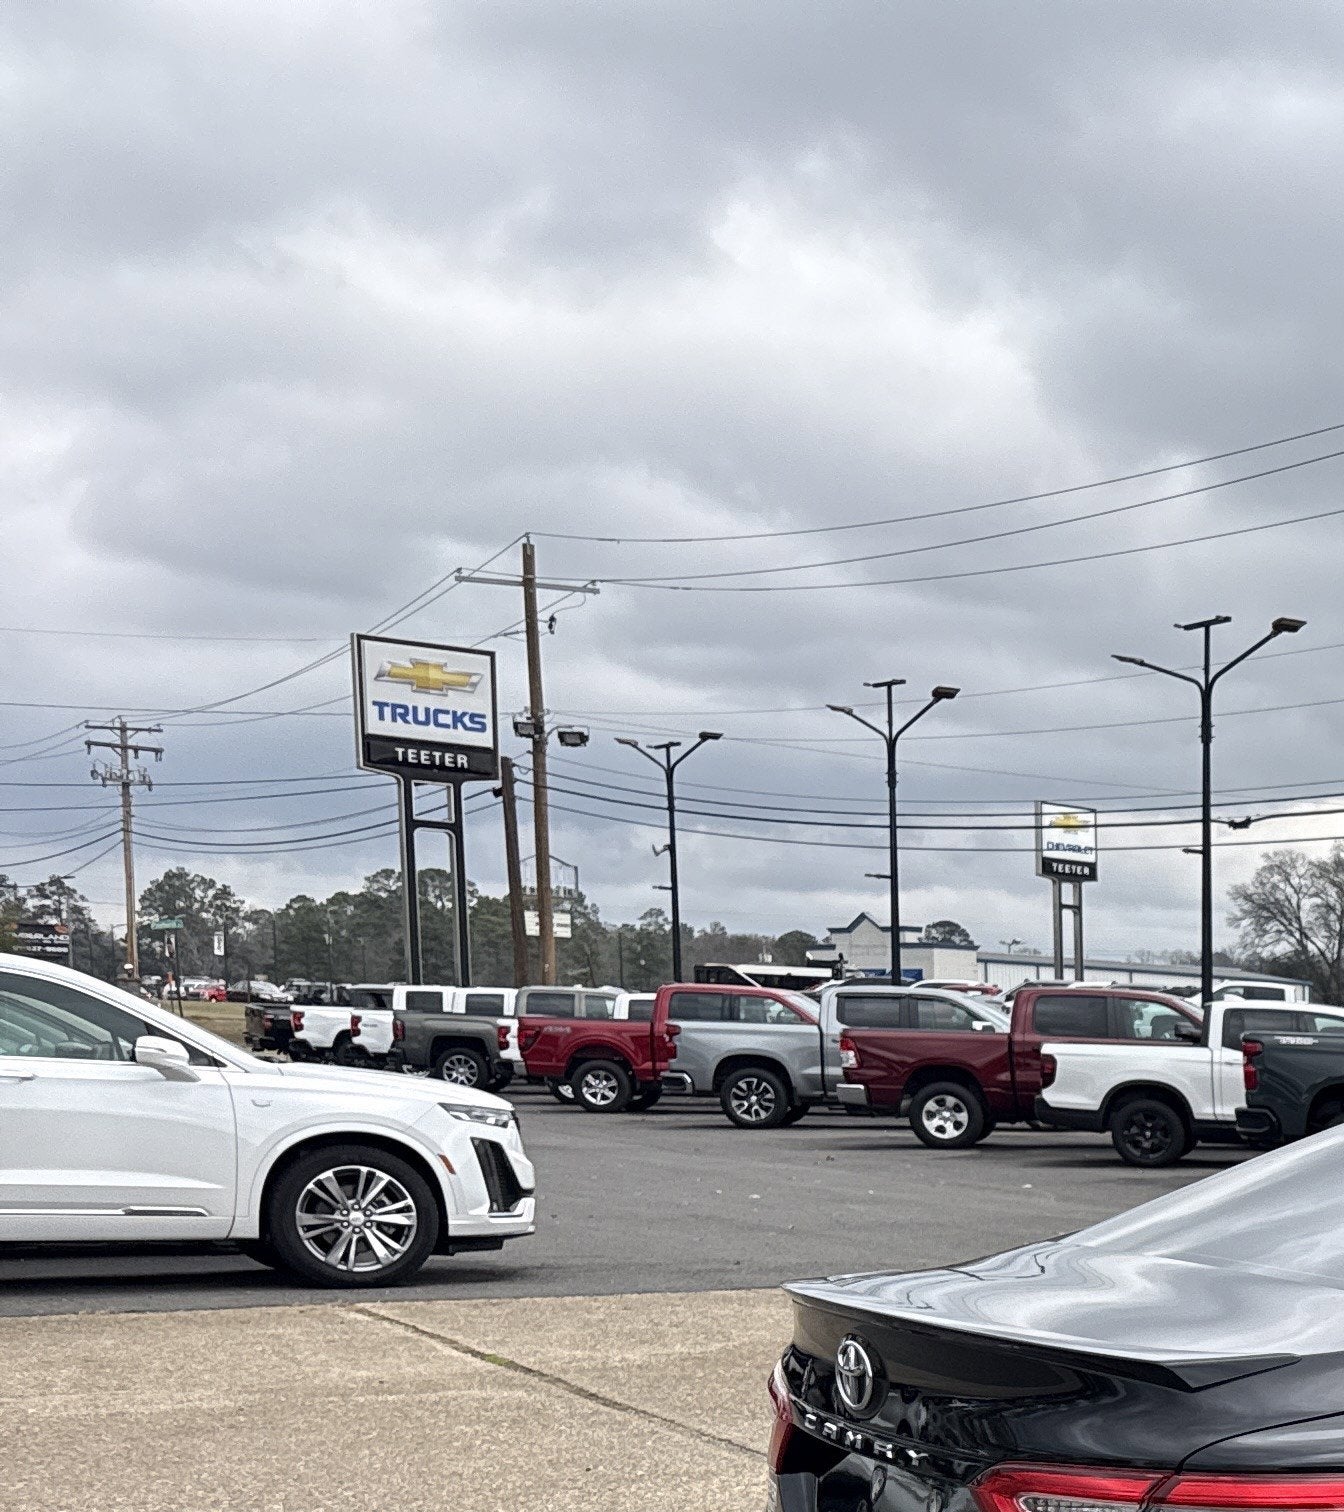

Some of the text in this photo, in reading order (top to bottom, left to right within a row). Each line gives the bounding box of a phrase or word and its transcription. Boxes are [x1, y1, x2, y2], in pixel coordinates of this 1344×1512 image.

[372, 700, 487, 733] TRUCKS
[395, 747, 468, 769] TEETER
[1052, 862, 1090, 876] TEETER
[804, 1413, 930, 1467] CAMRY
